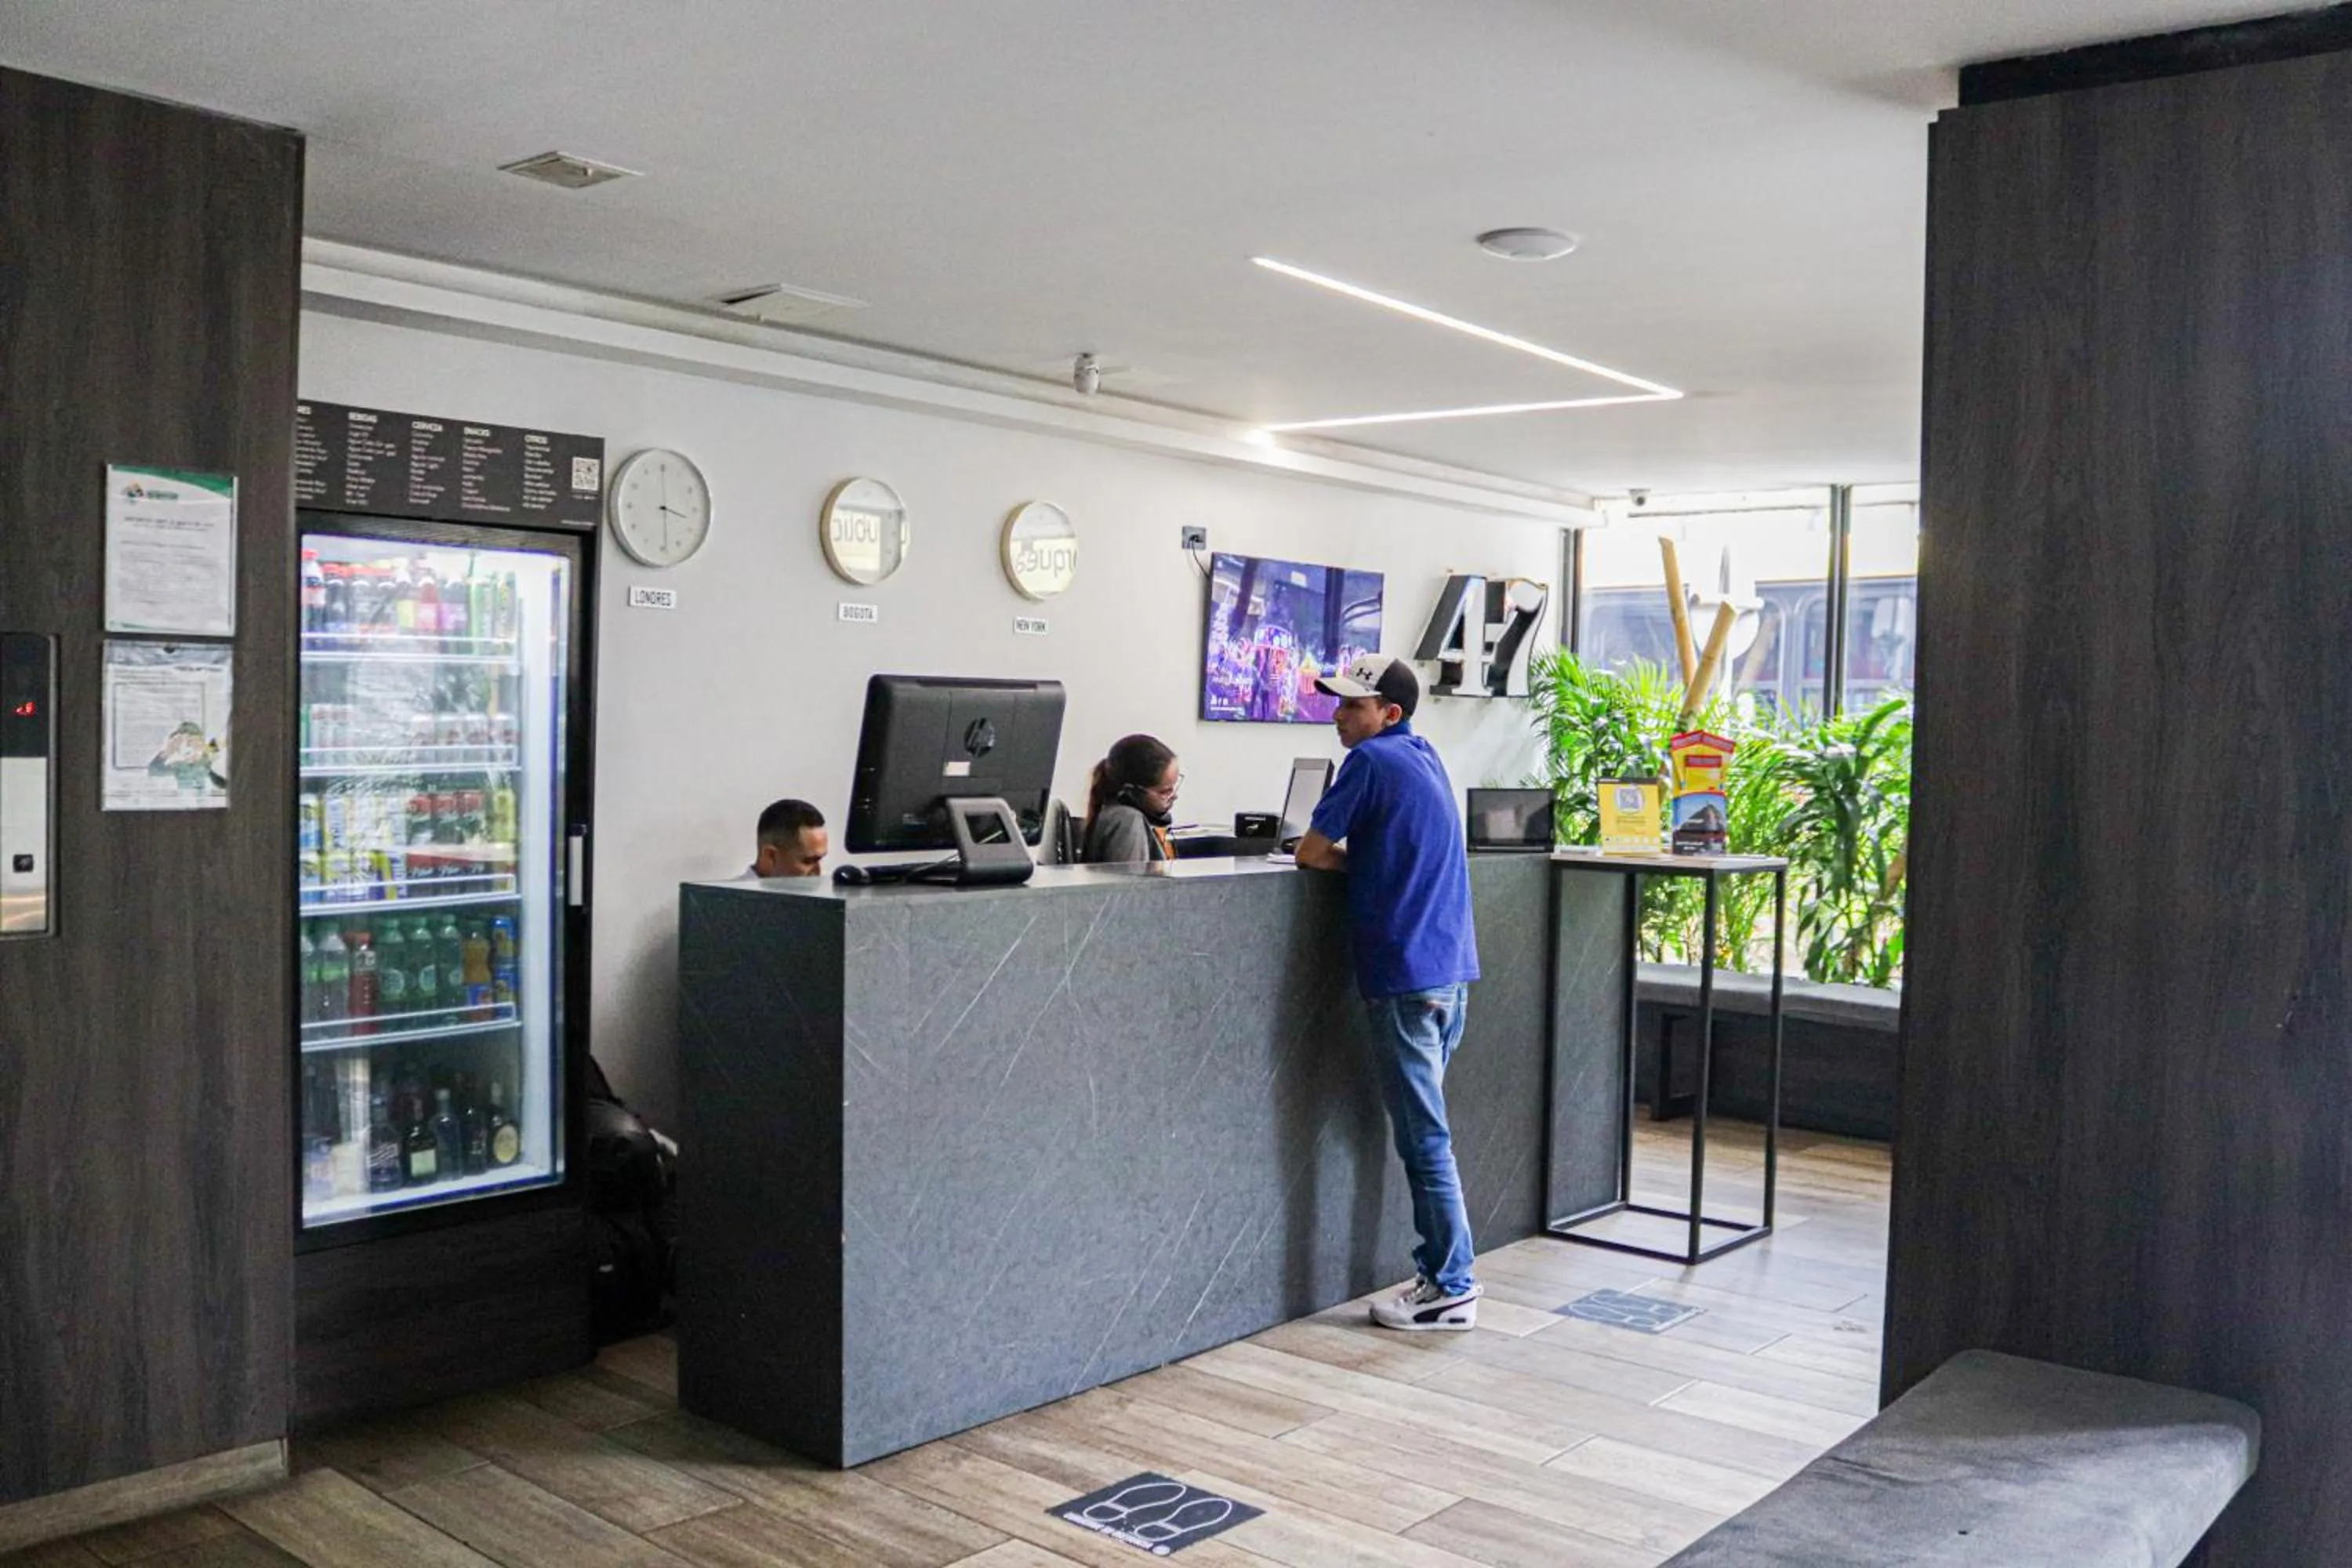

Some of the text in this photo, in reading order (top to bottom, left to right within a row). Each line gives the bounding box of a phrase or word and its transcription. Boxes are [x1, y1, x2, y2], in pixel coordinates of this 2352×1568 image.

[634, 589, 672, 606] LONDRES
[842, 605, 873, 620] BOGOTA
[1016, 619, 1046, 633] NEW YORK
[1414, 575, 1548, 698] 47
